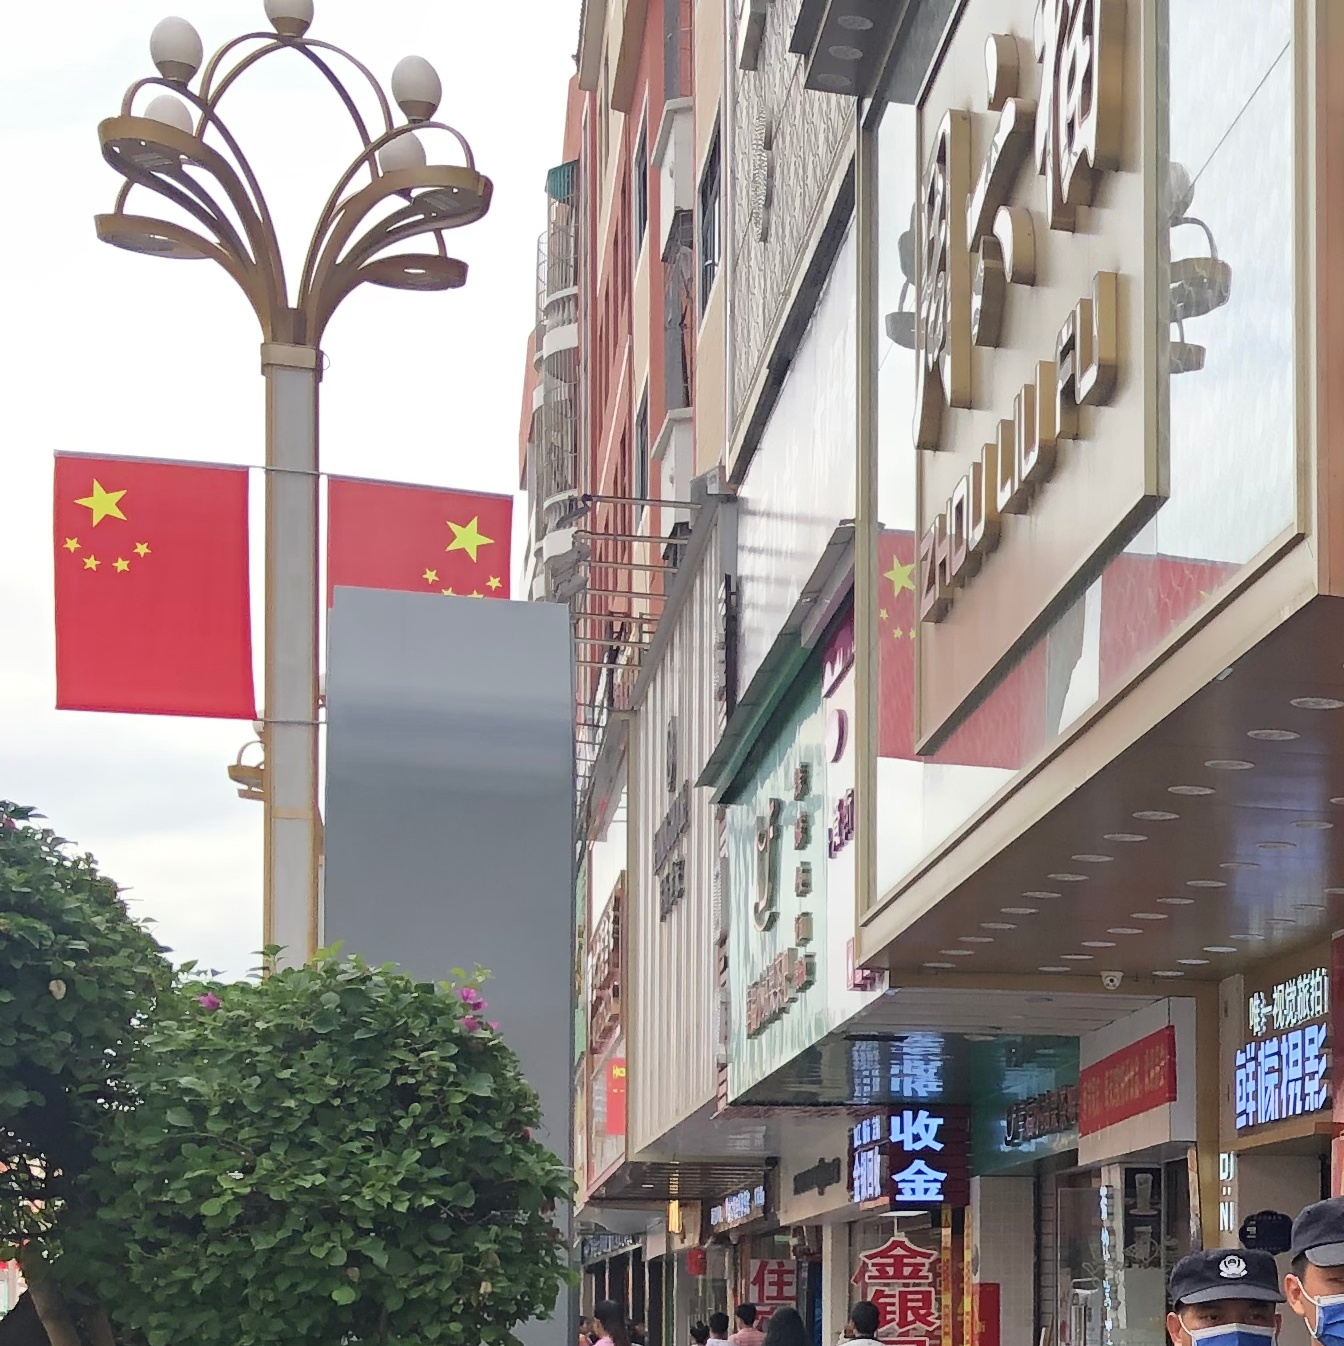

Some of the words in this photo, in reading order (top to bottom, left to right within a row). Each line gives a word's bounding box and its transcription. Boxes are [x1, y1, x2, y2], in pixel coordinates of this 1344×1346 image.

[1249, 968, 1328, 1037] 唯一视觉旅拍
[889, 1110, 948, 1202] 收金
